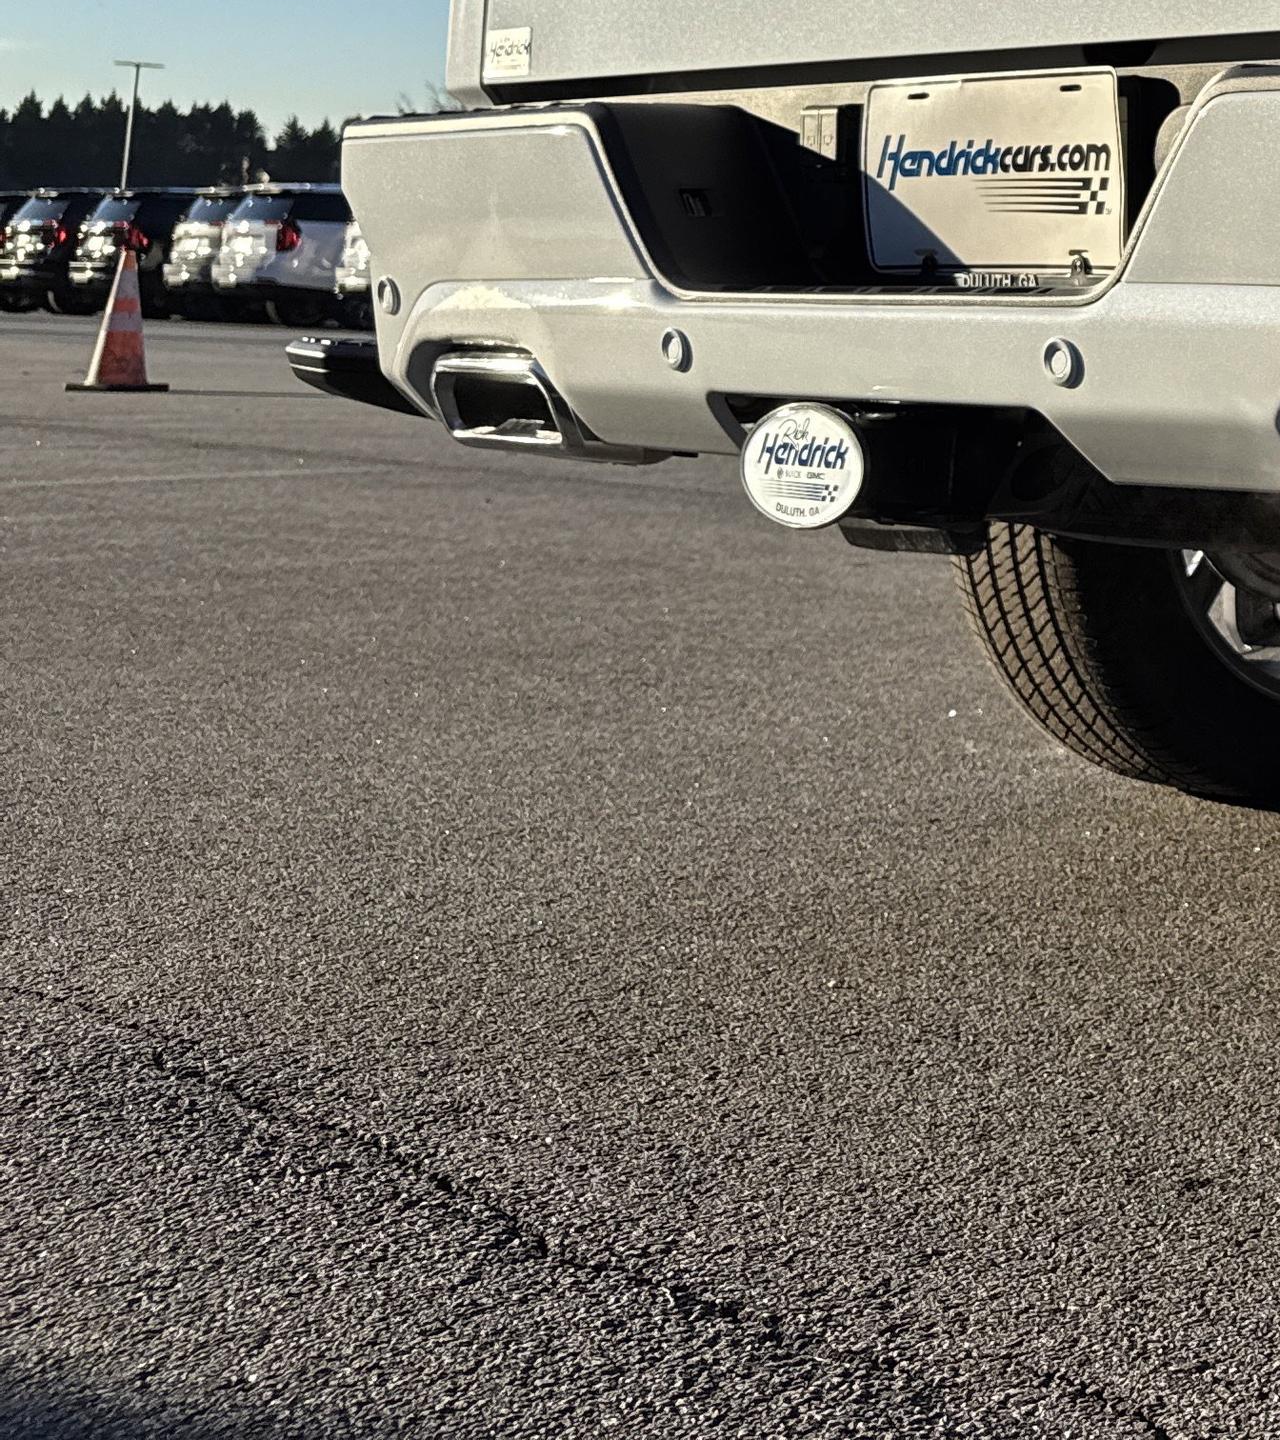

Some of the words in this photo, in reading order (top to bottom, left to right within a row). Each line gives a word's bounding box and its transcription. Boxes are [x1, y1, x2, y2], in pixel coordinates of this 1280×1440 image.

[876, 133, 1112, 192] Hendrickcars.com
[1018, 272, 1039, 288] GA
[757, 432, 849, 475] Hendrick
[808, 506, 820, 517] GA
